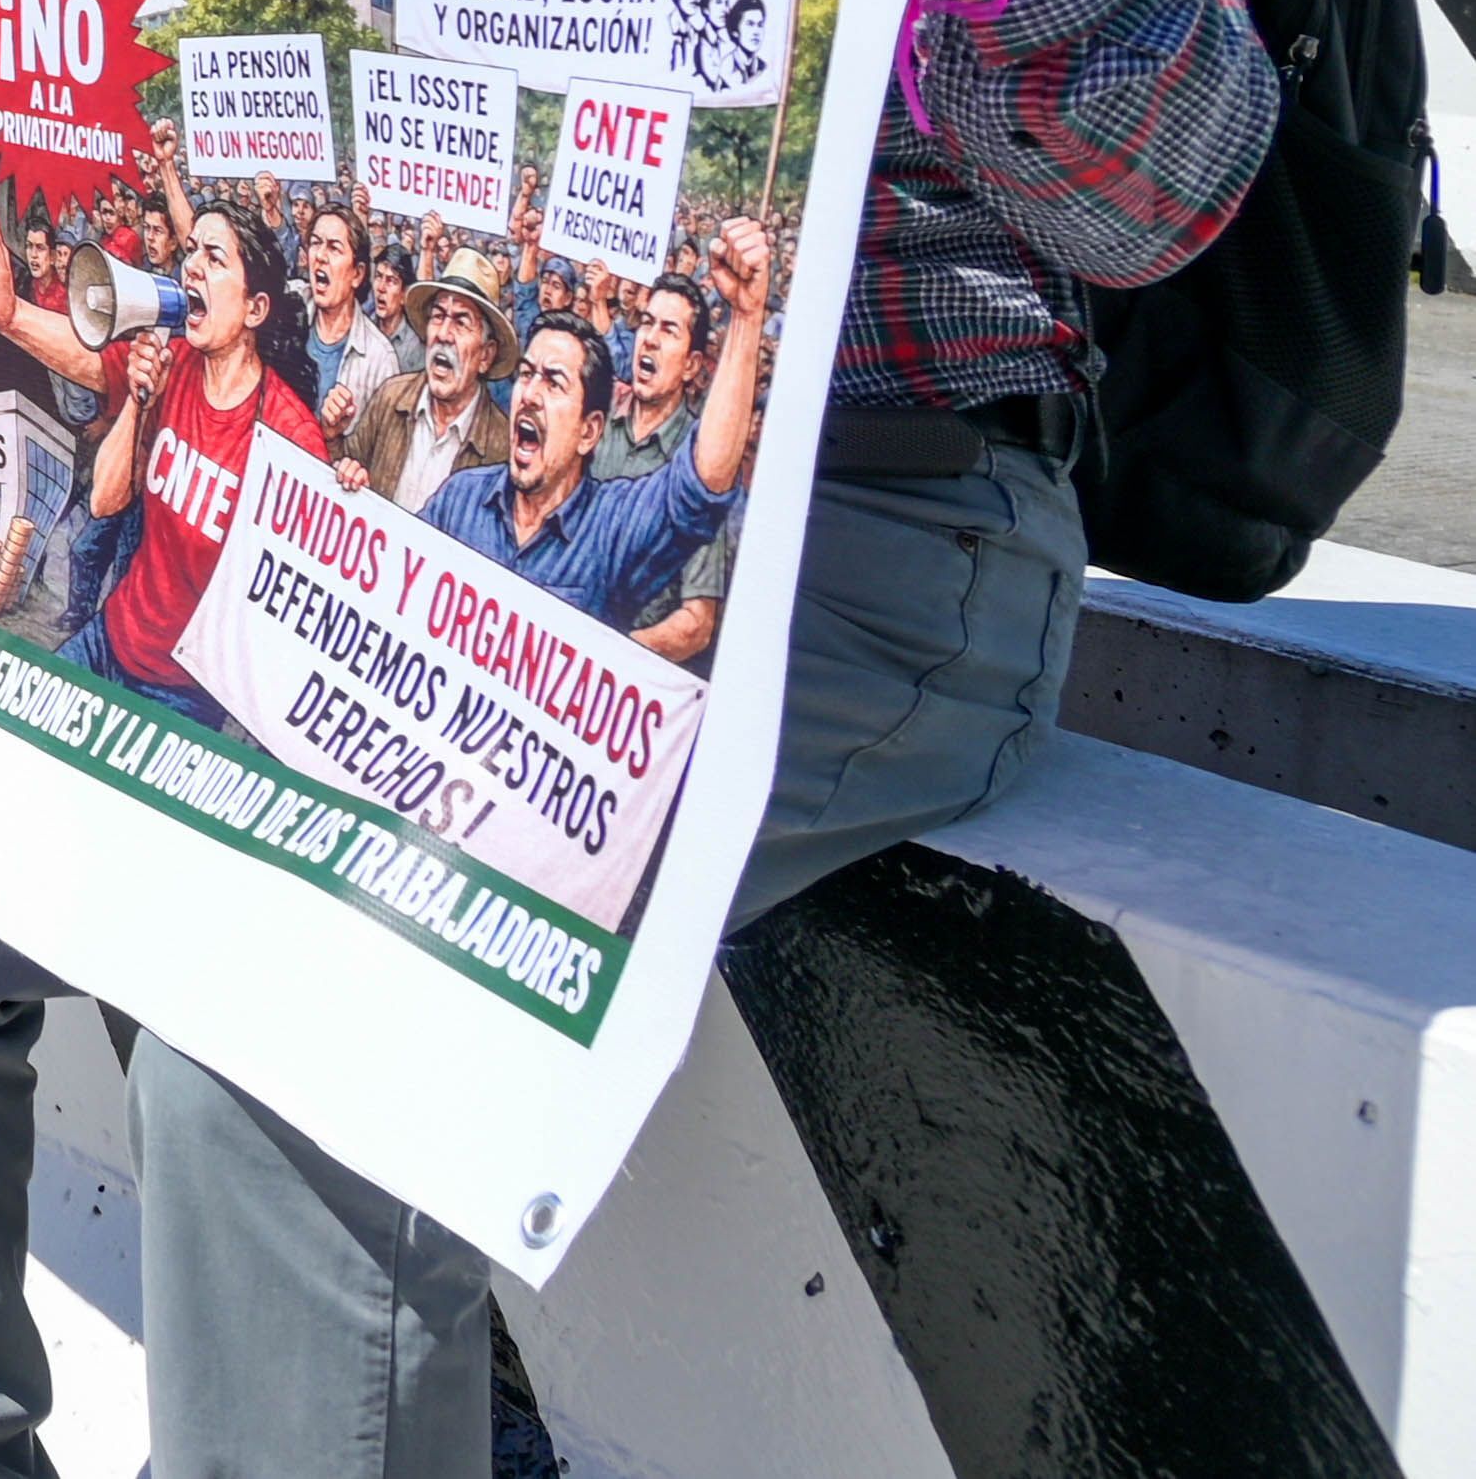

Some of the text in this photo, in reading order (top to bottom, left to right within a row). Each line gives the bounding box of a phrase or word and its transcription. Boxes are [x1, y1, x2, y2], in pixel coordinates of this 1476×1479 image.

[435, 4, 652, 56] Y ORGANIZACIÓN!
[191, 44, 312, 83] ¡LA PENSIÓN
[30, 80, 73, 117] A LA
[191, 88, 324, 123] ES UN DERECHO,
[193, 130, 325, 162] NO UN NEGOCIO!
[573, 99, 669, 168] CNTE
[567, 161, 645, 218] LUCHA
[552, 206, 657, 264] Y RESISTENCIA
[147, 426, 239, 544] CNTE
[253, 461, 665, 779] ¡UNIDOS Y ORGANIZADOS
[89, 704, 127, 758] Y
[246, 550, 617, 857] DEFENDEMOS NUESTROS
[107, 715, 158, 777] LA
[284, 670, 498, 848] DERECHOS!
[141, 732, 276, 838] DIGNIDAD
[258, 789, 309, 849] DE
[293, 804, 356, 863] LOS
[332, 811, 602, 1015] TRABAJADORES
